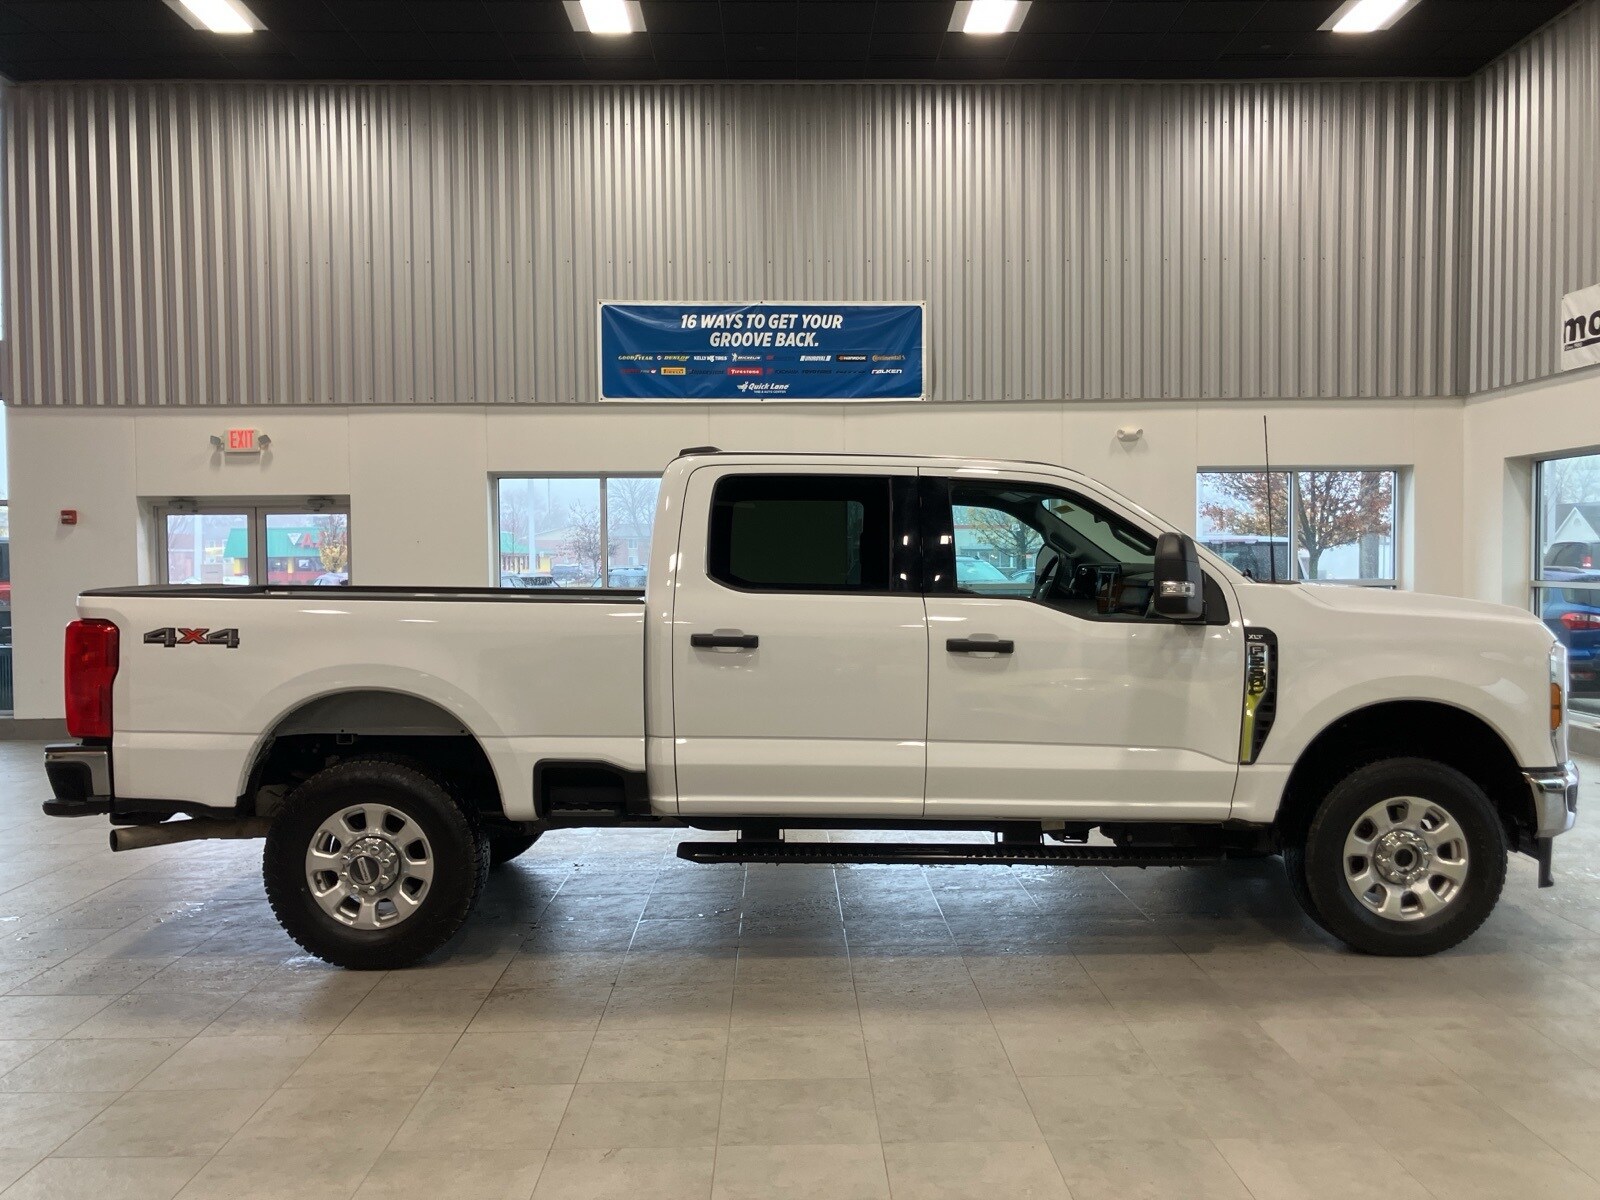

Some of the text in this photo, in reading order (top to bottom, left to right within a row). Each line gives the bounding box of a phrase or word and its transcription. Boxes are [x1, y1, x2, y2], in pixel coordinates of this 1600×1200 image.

[681, 314, 843, 329] 16 WAYS TO GET YOUR
[709, 332, 819, 347] GROOVE BACK.
[748, 382, 790, 391] Quick Lane
[230, 430, 254, 448] EXIT
